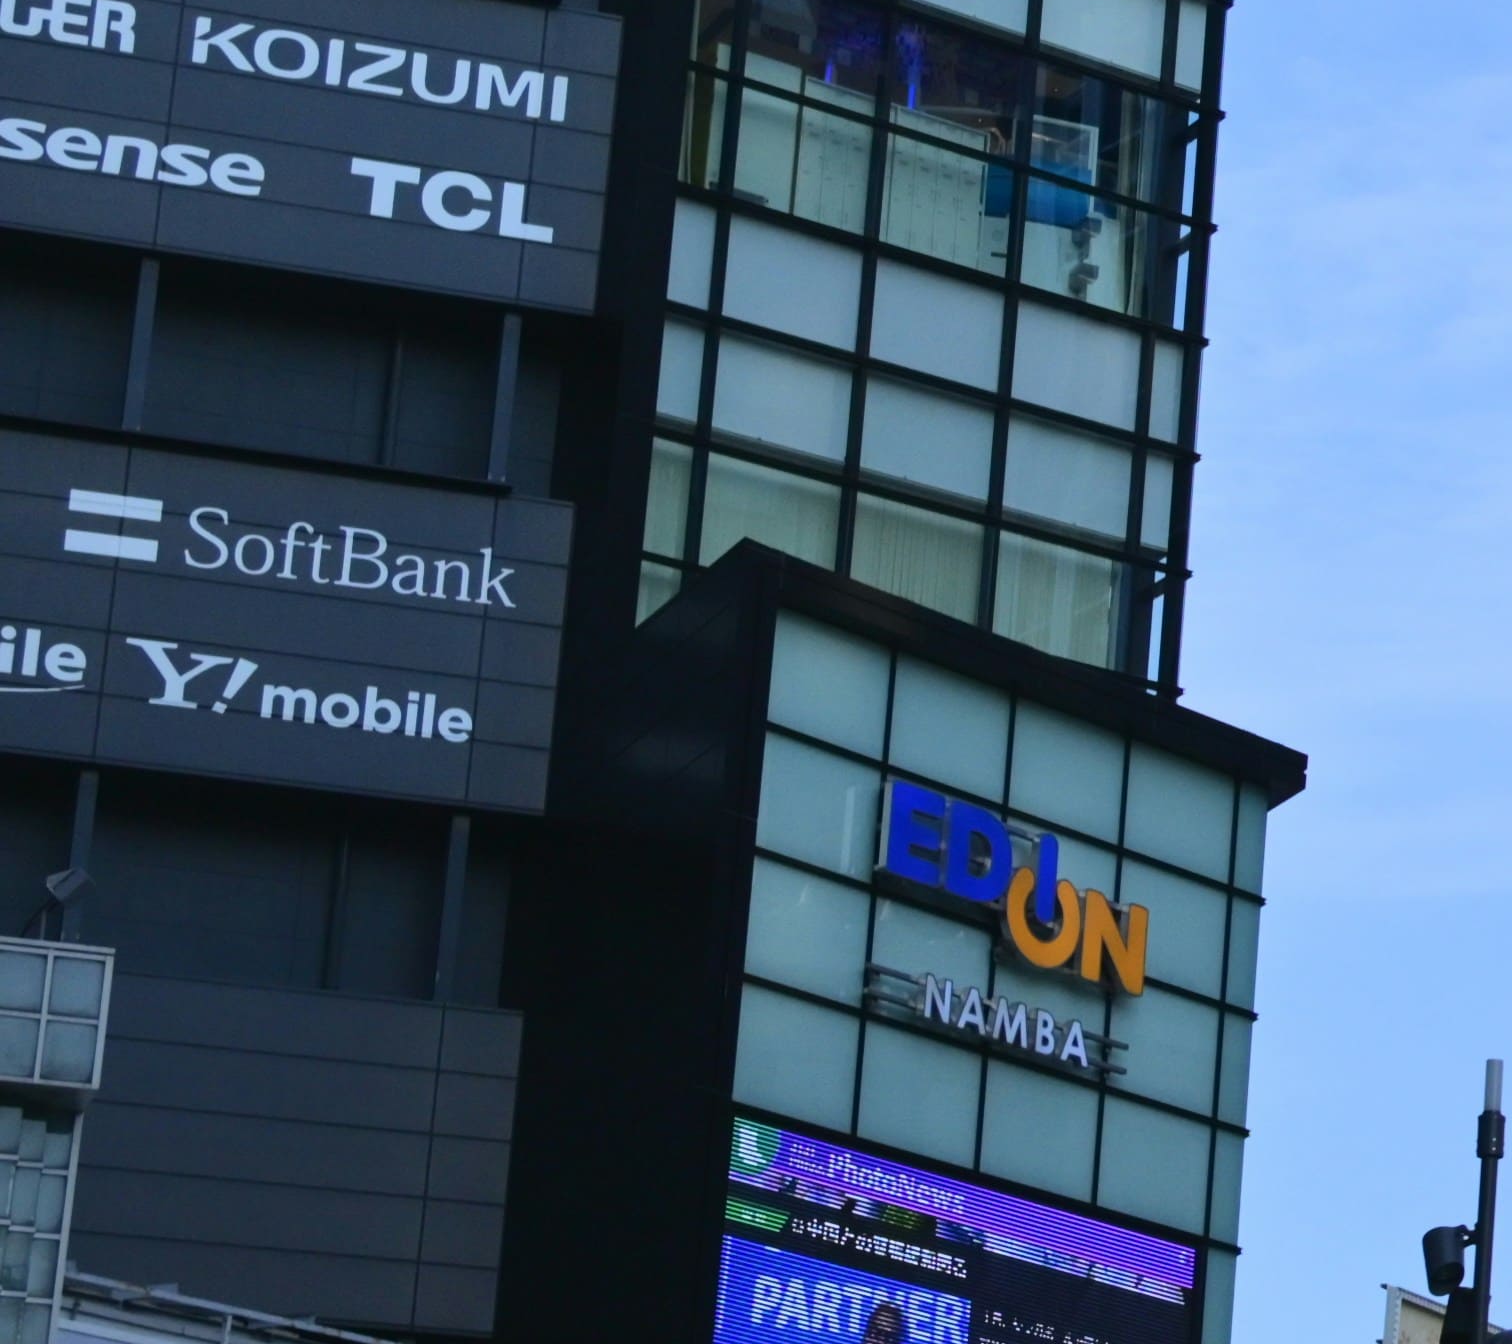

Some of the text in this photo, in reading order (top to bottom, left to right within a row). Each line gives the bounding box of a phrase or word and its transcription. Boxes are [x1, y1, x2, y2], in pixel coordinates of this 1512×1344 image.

[191, 17, 570, 123] KOIZUMI
[0, 117, 266, 197] sense
[350, 159, 554, 244] TCL
[183, 506, 517, 609] SoftBank
[884, 778, 1149, 997] EDION
[922, 972, 1089, 1068] NAMBA
